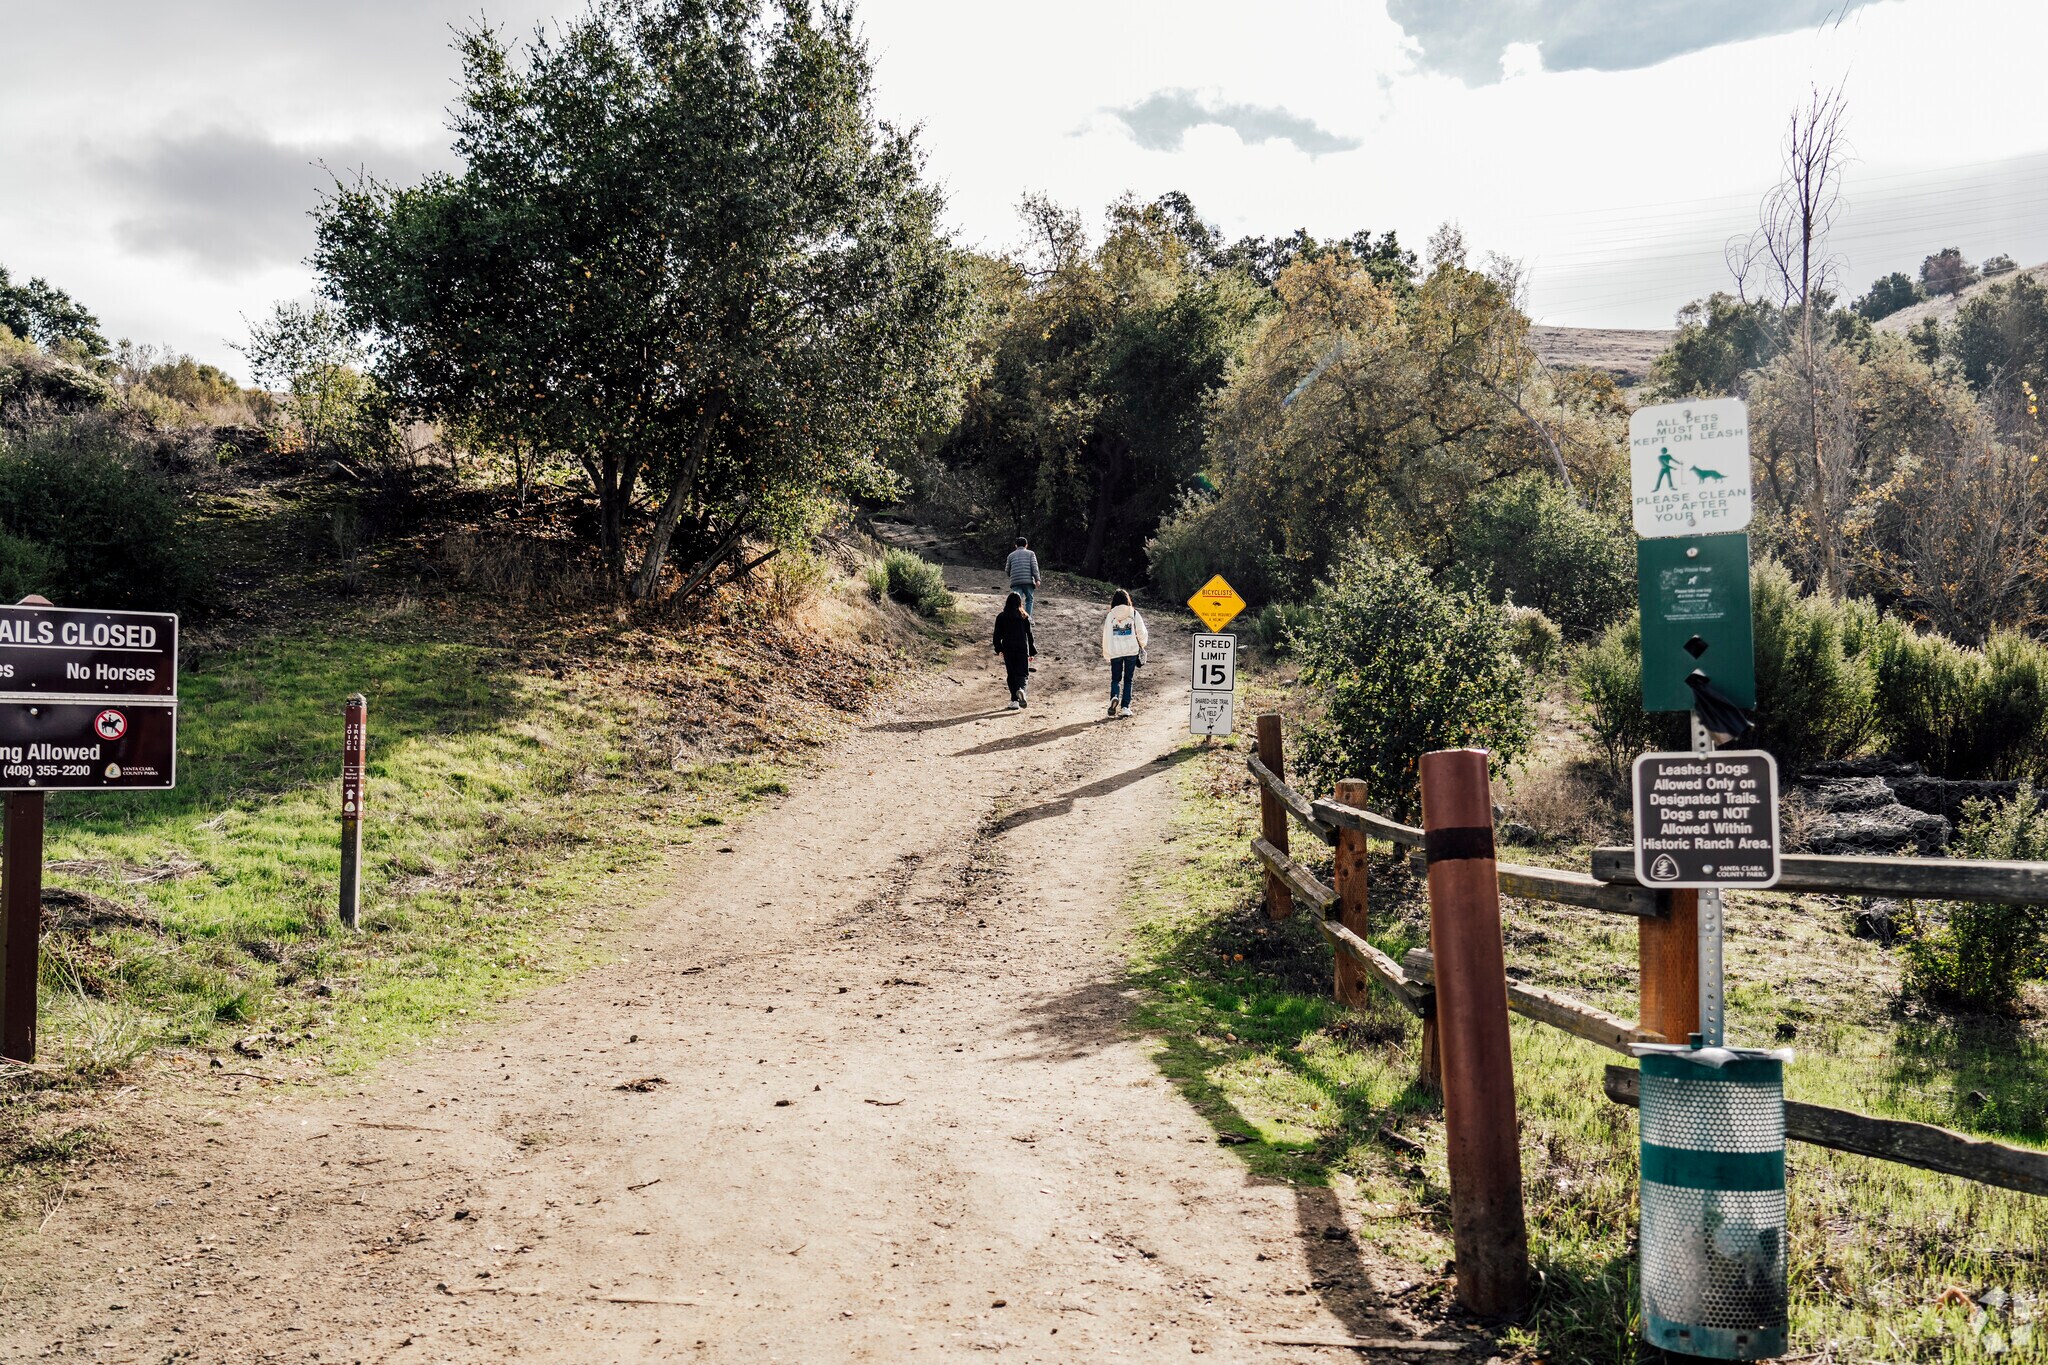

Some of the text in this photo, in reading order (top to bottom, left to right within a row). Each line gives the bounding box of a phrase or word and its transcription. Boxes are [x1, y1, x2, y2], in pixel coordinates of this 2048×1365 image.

[1657, 413, 1718, 428] ALL PETS
[1656, 422, 1718, 436] MUST BE
[1633, 428, 1743, 446] KEPT ON LEASH
[1636, 488, 1746, 506] PLEASE CLEAN
[1655, 499, 1727, 513] UP AFTER
[1655, 508, 1729, 522] YOUR PET
[0, 619, 157, 648] AILS CLOSED
[1198, 639, 1231, 649] SPEED
[1201, 652, 1226, 661] LIMIT
[66, 662, 156, 682] No Horses
[1200, 664, 1226, 685] 15
[0, 743, 101, 764] ng Allowed
[3, 764, 91, 778] (408) 355-2200
[1658, 762, 1749, 776] Leashed Dogs
[1653, 778, 1756, 791] Allowed Only on
[1649, 792, 1760, 807] Designated Trails.
[1660, 807, 1750, 822] Dogs are NOT
[1660, 822, 1752, 835] Allowed Within
[1642, 838, 1772, 850] Historic Ranch Area.
